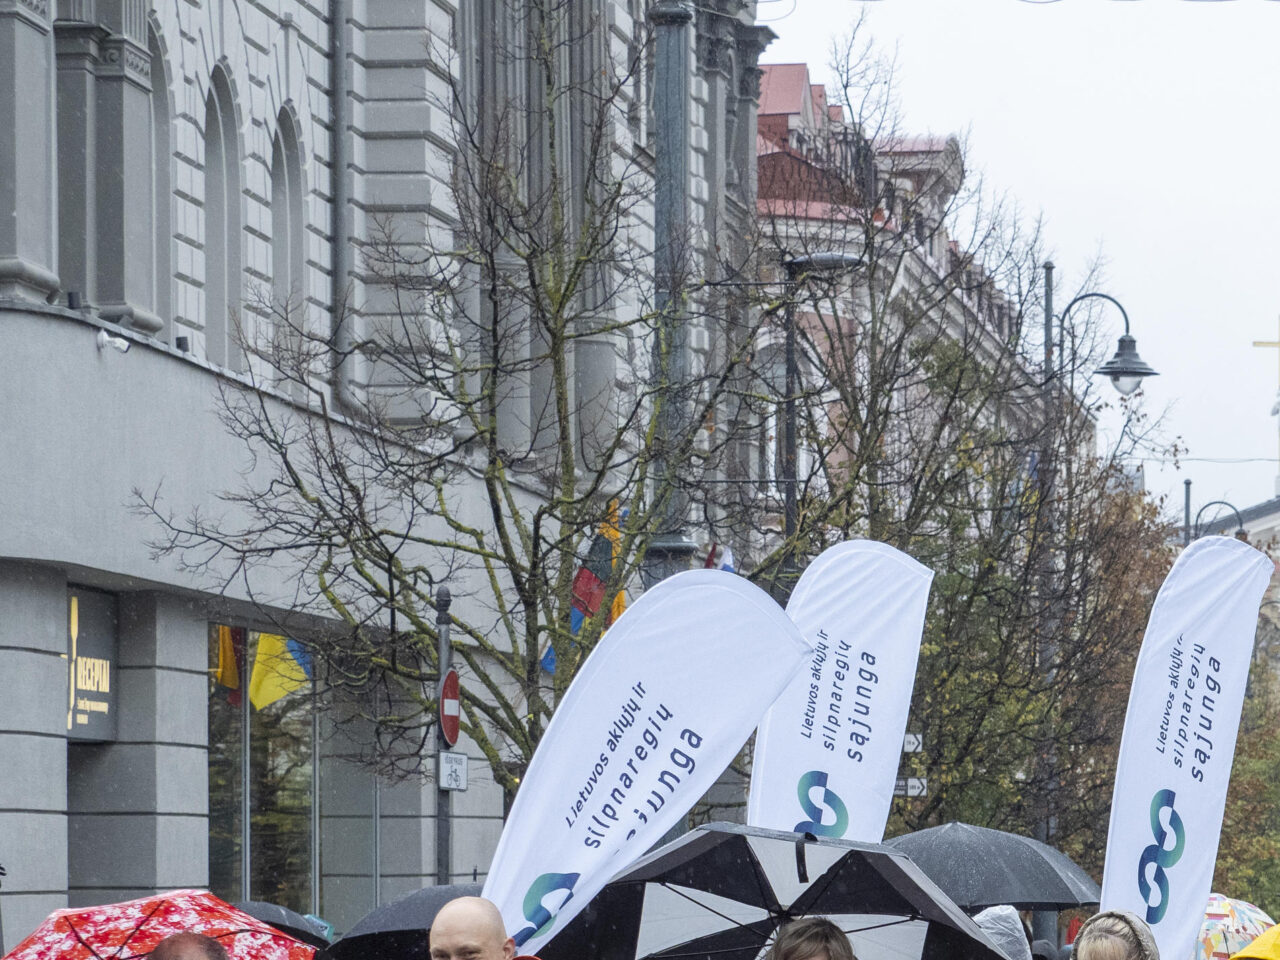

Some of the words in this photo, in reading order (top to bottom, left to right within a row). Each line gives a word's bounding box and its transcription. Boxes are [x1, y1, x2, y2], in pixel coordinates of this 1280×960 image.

[810, 642, 829, 681] aklųjų
[816, 629, 828, 640] ir
[801, 683, 819, 739] Lietuvos
[822, 640, 852, 751] silpnaregių
[847, 651, 879, 763] sąjunga
[1156, 691, 1175, 754] Lietuvos
[1168, 647, 1183, 689] aklųjų
[1173, 643, 1206, 768] silpnaregių
[1191, 656, 1221, 782] sąjunga
[565, 753, 609, 829] Lietuvos
[606, 698, 642, 752] aklųjų
[632, 681, 646, 699] ir
[584, 703, 673, 849] silpnaregių
